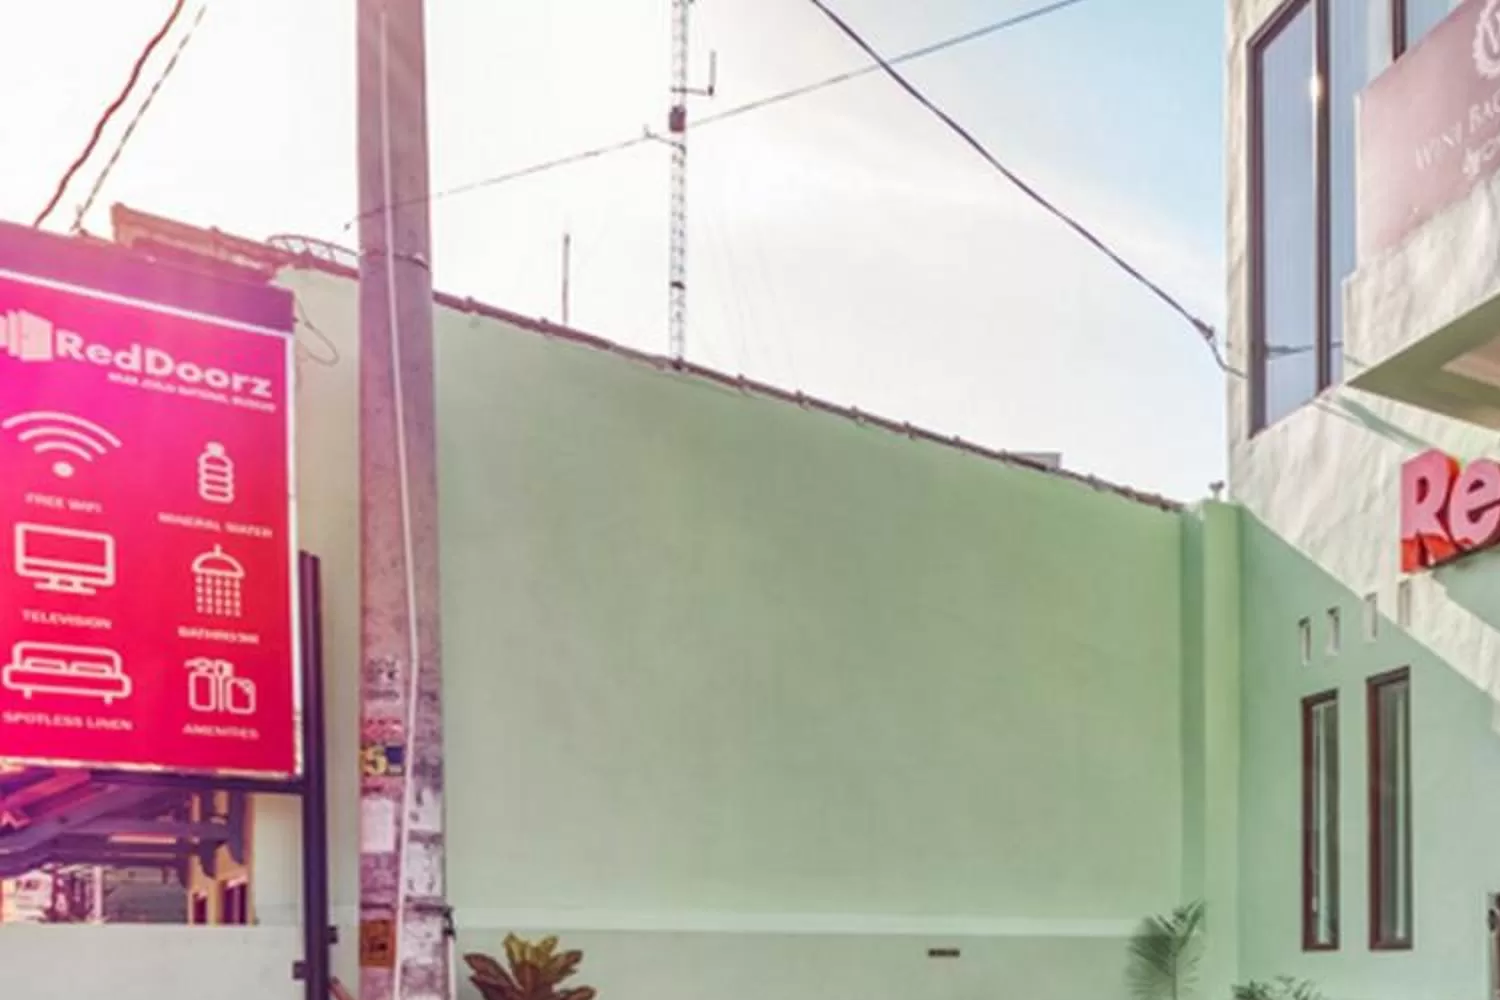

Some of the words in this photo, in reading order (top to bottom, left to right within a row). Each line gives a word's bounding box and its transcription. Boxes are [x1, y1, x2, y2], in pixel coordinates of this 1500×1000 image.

[55, 329, 273, 398] RedDoorz
[21, 608, 113, 630] TELEVISION
[1, 710, 84, 729] SPOTLESS
[86, 714, 133, 731] LINEN
